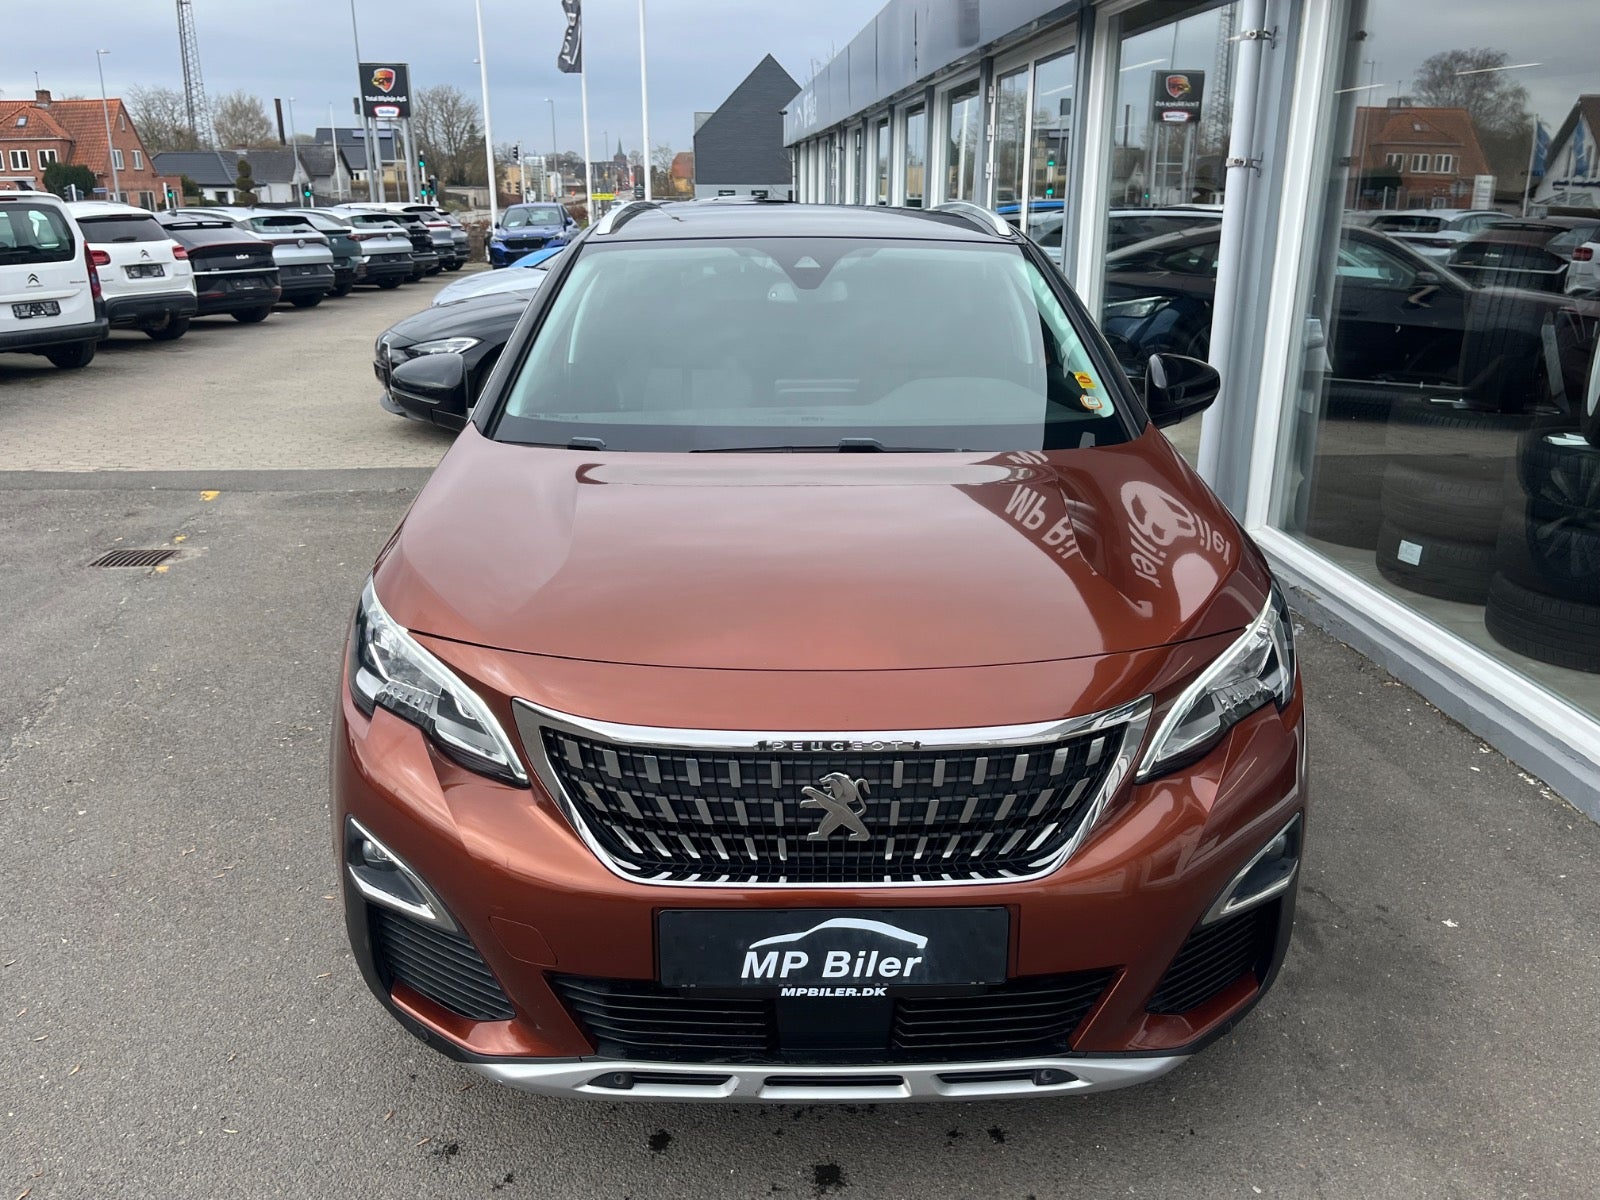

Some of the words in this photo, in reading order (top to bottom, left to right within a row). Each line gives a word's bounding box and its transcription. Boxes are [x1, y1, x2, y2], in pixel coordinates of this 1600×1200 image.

[772, 740, 903, 751] PEUGEOT
[740, 951, 809, 979] MP
[821, 950, 923, 979] Biler
[780, 987, 888, 998] MPBILER.DK
